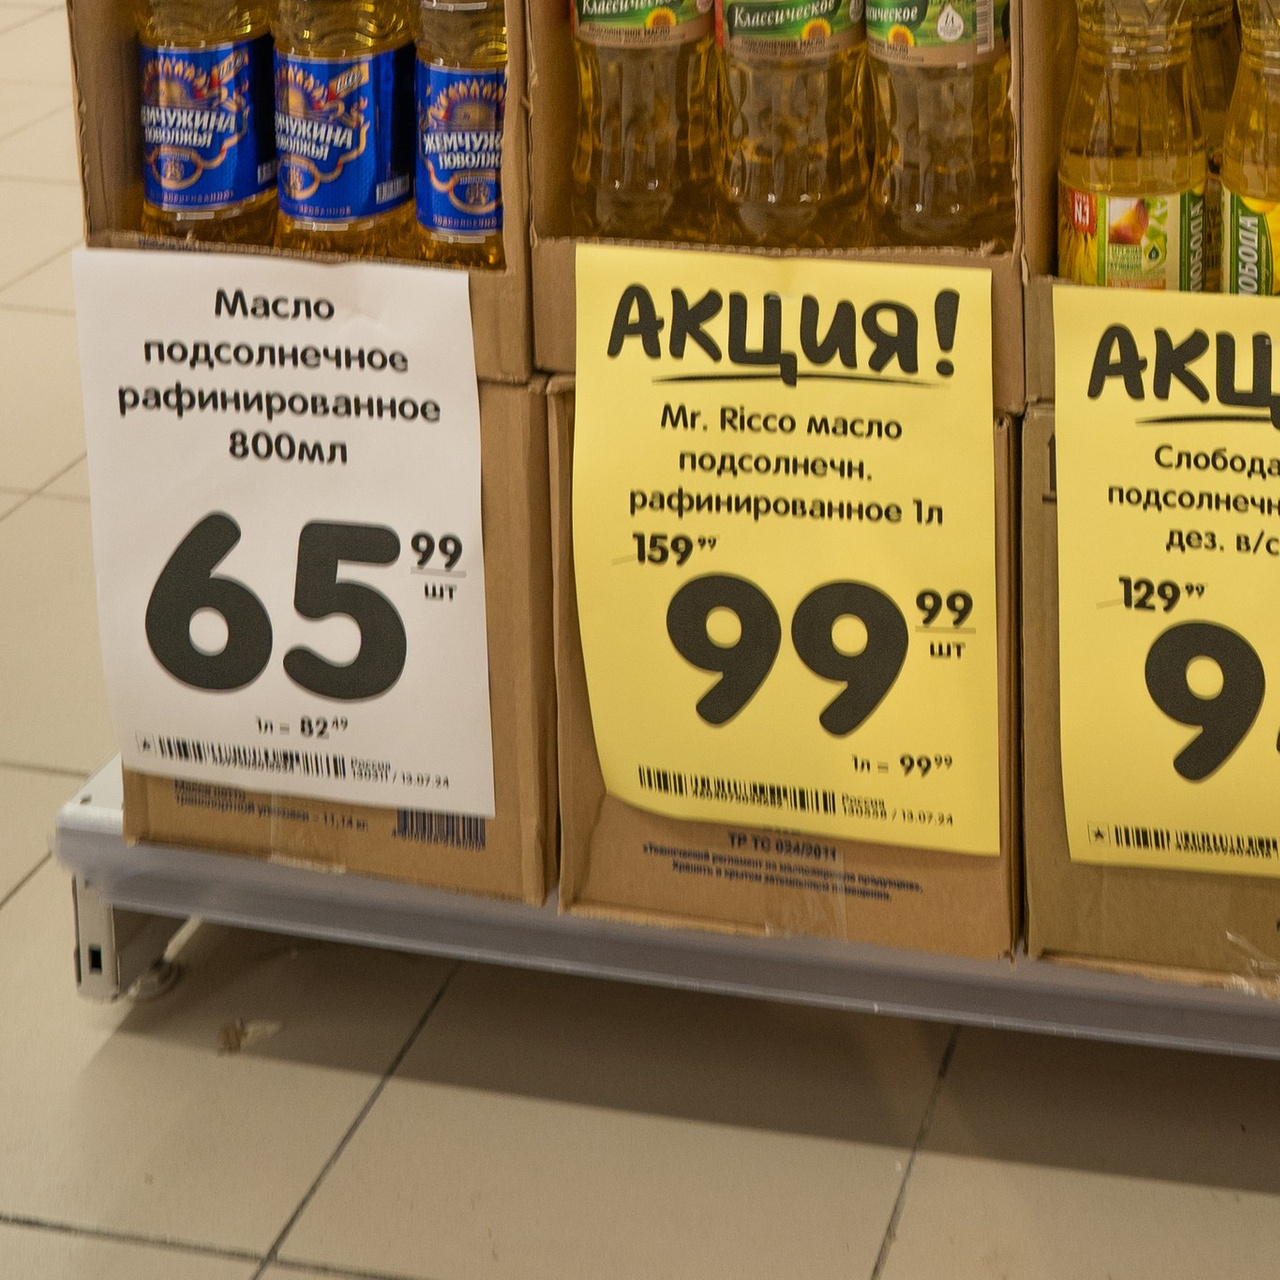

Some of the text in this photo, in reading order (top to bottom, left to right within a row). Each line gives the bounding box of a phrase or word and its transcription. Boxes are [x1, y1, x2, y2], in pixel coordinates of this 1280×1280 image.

[214, 288, 335, 320] Масло
[605, 280, 961, 388] АКЦИЯ!
[143, 341, 409, 373] подсолнечное
[118, 381, 441, 423] рафинированное
[660, 403, 903, 440] Mr. Ricco масло
[228, 430, 348, 464] 800мл
[679, 452, 872, 481] подсолнечн.
[629, 486, 943, 525] рафинированное 1л
[632, 530, 694, 568] 159
[1165, 529, 1225, 553] дез.
[1236, 530, 1280, 556] в/с
[144, 510, 463, 702] 65 99
[424, 583, 454, 601] шт
[1117, 572, 1183, 614] 129
[664, 570, 975, 741] 99 99
[929, 642, 962, 659] шт
